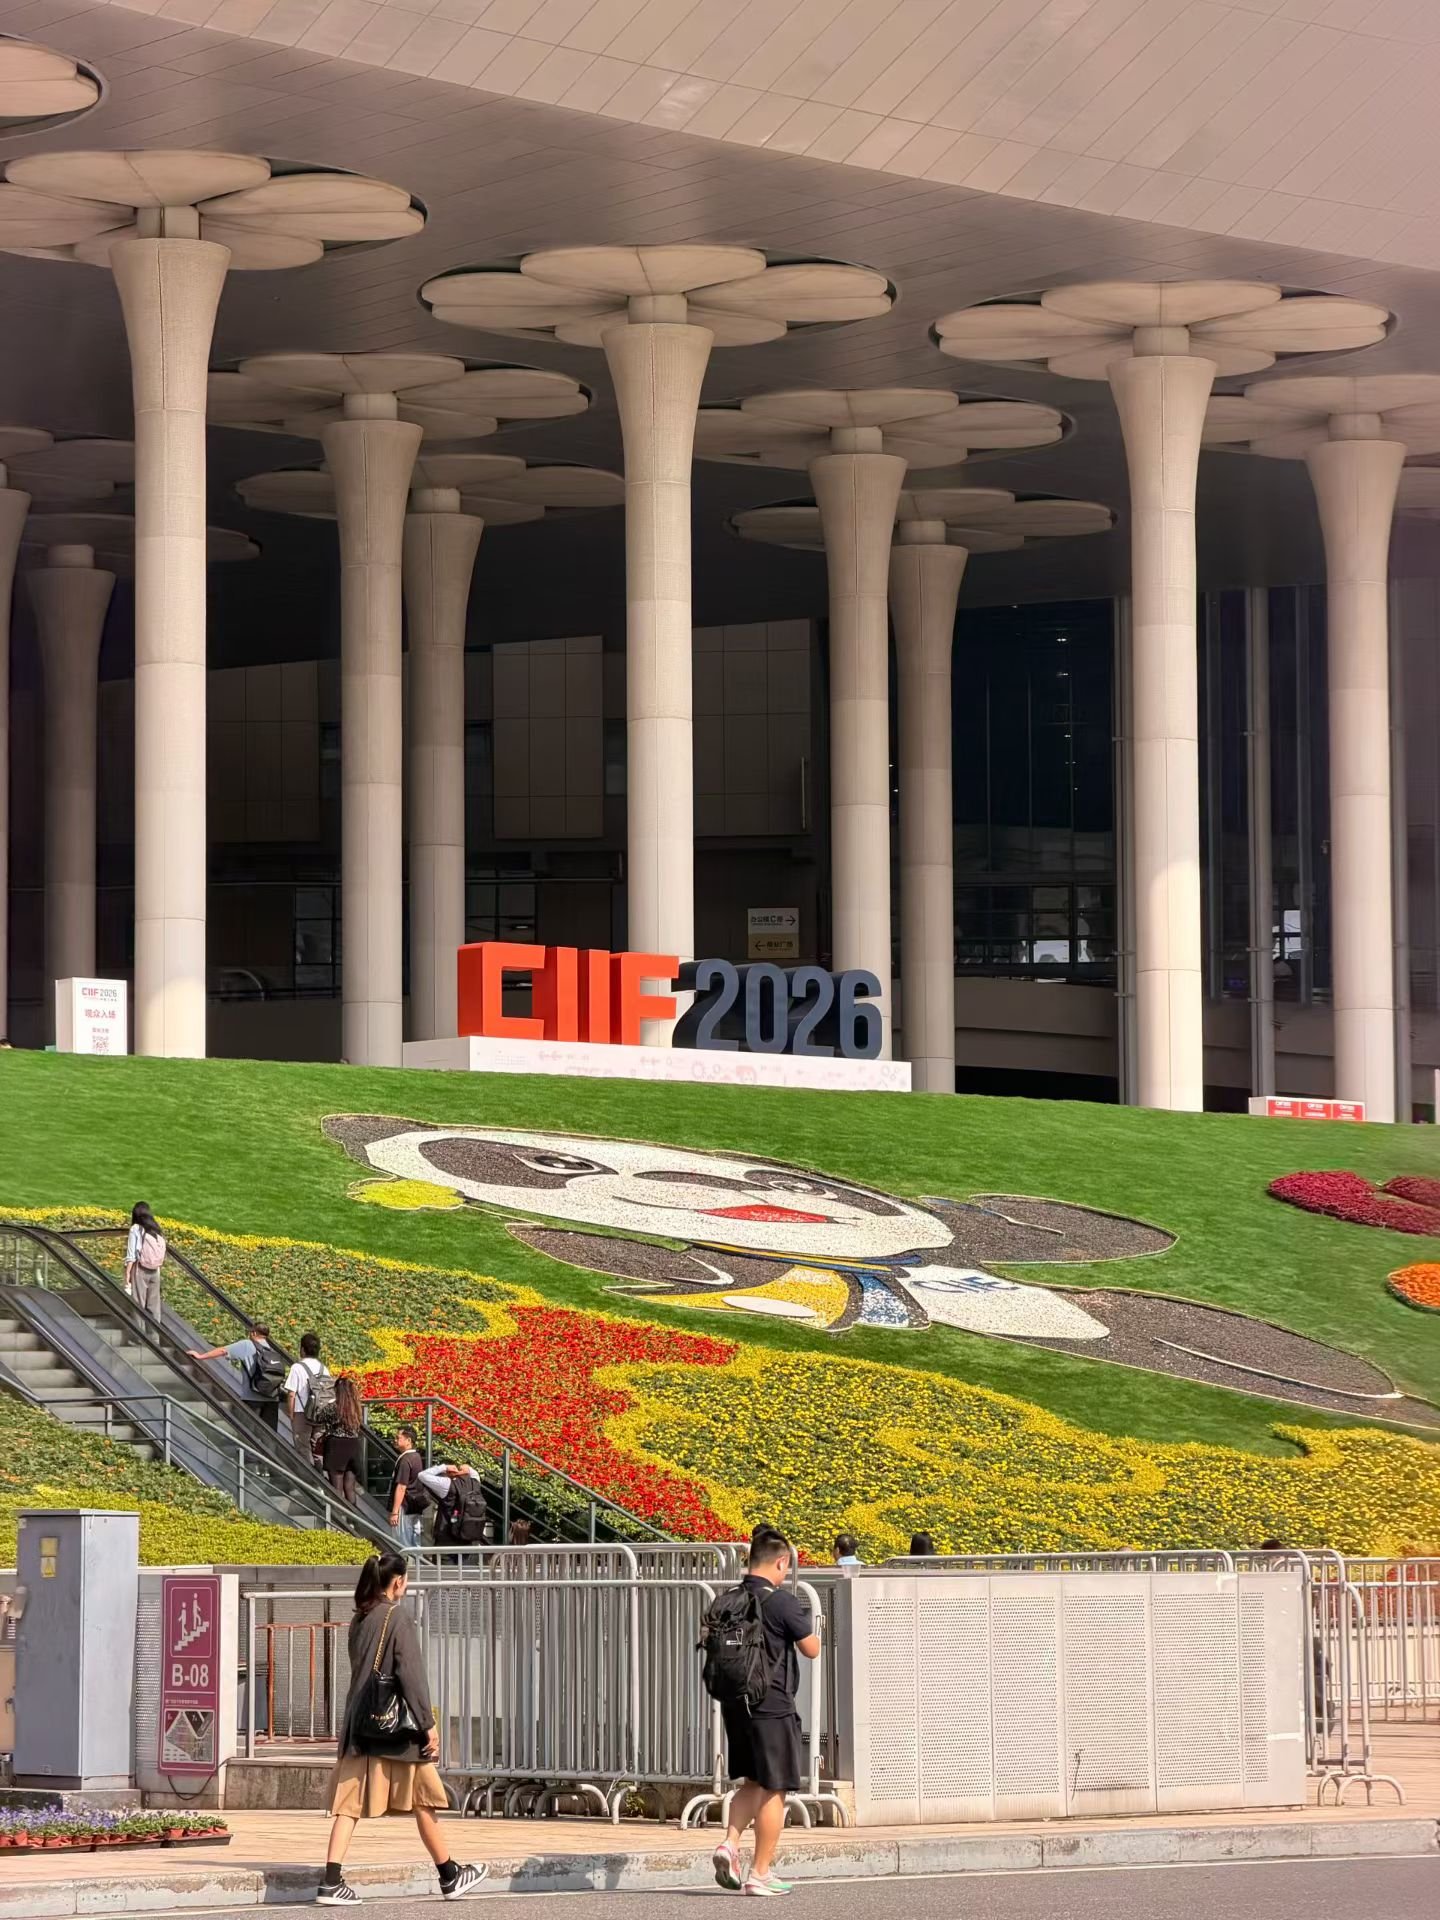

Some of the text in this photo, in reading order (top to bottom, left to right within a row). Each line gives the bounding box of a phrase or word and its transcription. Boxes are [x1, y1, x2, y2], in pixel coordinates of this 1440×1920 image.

[81, 987, 117, 997] CIIF 2026
[458, 942, 883, 1060] CIIF 2026
[84, 1009, 116, 1019] 观众入场
[172, 1664, 209, 1687] B-08
